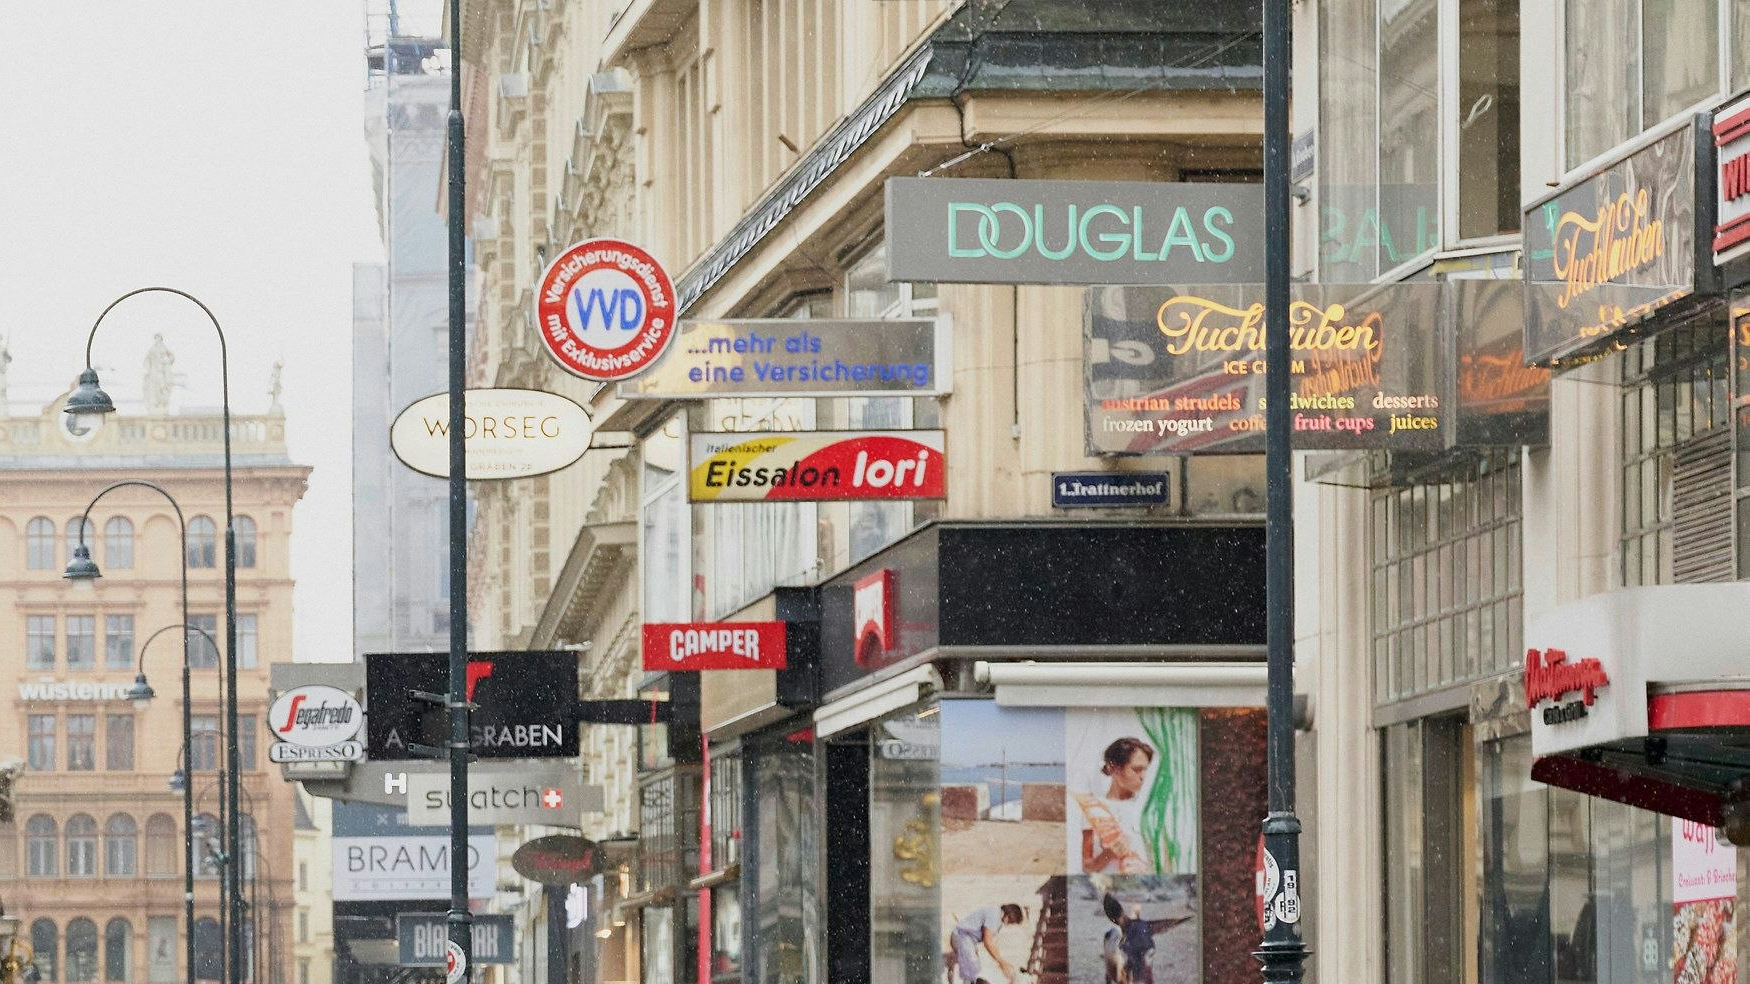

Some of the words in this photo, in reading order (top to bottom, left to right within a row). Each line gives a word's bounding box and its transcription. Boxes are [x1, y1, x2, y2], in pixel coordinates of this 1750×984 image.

[948, 202, 1235, 262] DOUGLAS
[1554, 189, 1663, 308] Tuchlauben
[545, 250, 668, 308] Versicherungsdienst
[575, 288, 642, 330] VVD
[1157, 295, 1378, 354] Tuchuben
[547, 314, 568, 342] mit
[561, 317, 665, 371] Exklusivservice
[785, 330, 821, 353] als
[689, 361, 744, 382] eine
[753, 360, 929, 386] Versicherung
[1224, 361, 1247, 374] ICE
[1102, 395, 1170, 411] austrian
[1175, 393, 1241, 411] strudels
[1259, 391, 1355, 410] sdwiches
[1373, 391, 1439, 409] desserts
[1104, 416, 1154, 432] frozen
[1158, 416, 1213, 436] yogurt
[1294, 414, 1330, 430] fruit
[1336, 419, 1374, 434] cups
[1389, 414, 1438, 434] juices
[706, 442, 777, 454] italienischer
[706, 461, 840, 488] Eissalon
[670, 629, 760, 662] CAMPER
[279, 695, 353, 732] Segafredo
[279, 745, 355, 759] ESPRESSO
[426, 785, 540, 810] satch
